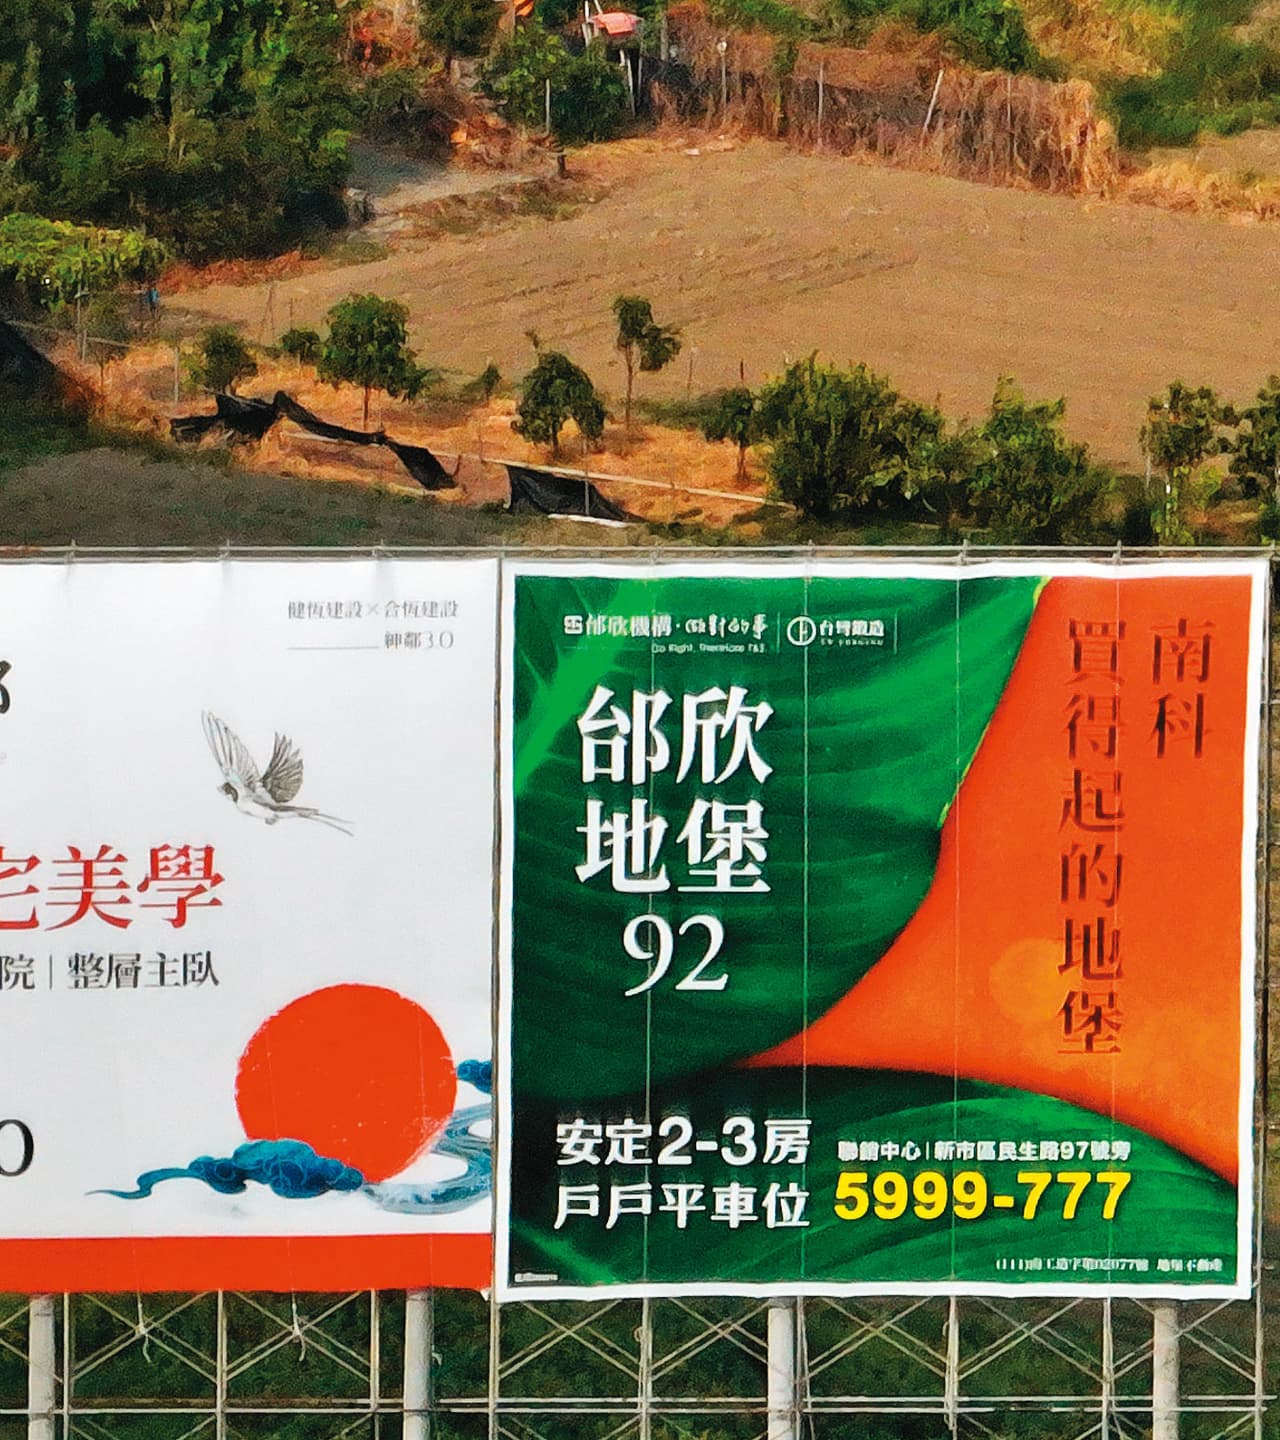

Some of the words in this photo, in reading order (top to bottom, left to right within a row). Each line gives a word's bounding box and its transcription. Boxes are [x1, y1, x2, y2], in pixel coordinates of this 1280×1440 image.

[1149, 616, 1212, 760] 南科
[576, 682, 775, 786] 邰欣
[574, 796, 773, 895] 地堡
[1055, 615, 1126, 1057] 買得起的地堡
[66, 951, 221, 991] 整層主臥
[621, 913, 731, 997] 92
[554, 1114, 813, 1168] 安定2-3房
[554, 1181, 812, 1231] 戶戶平車位
[833, 1168, 1133, 1223] 5999-777
